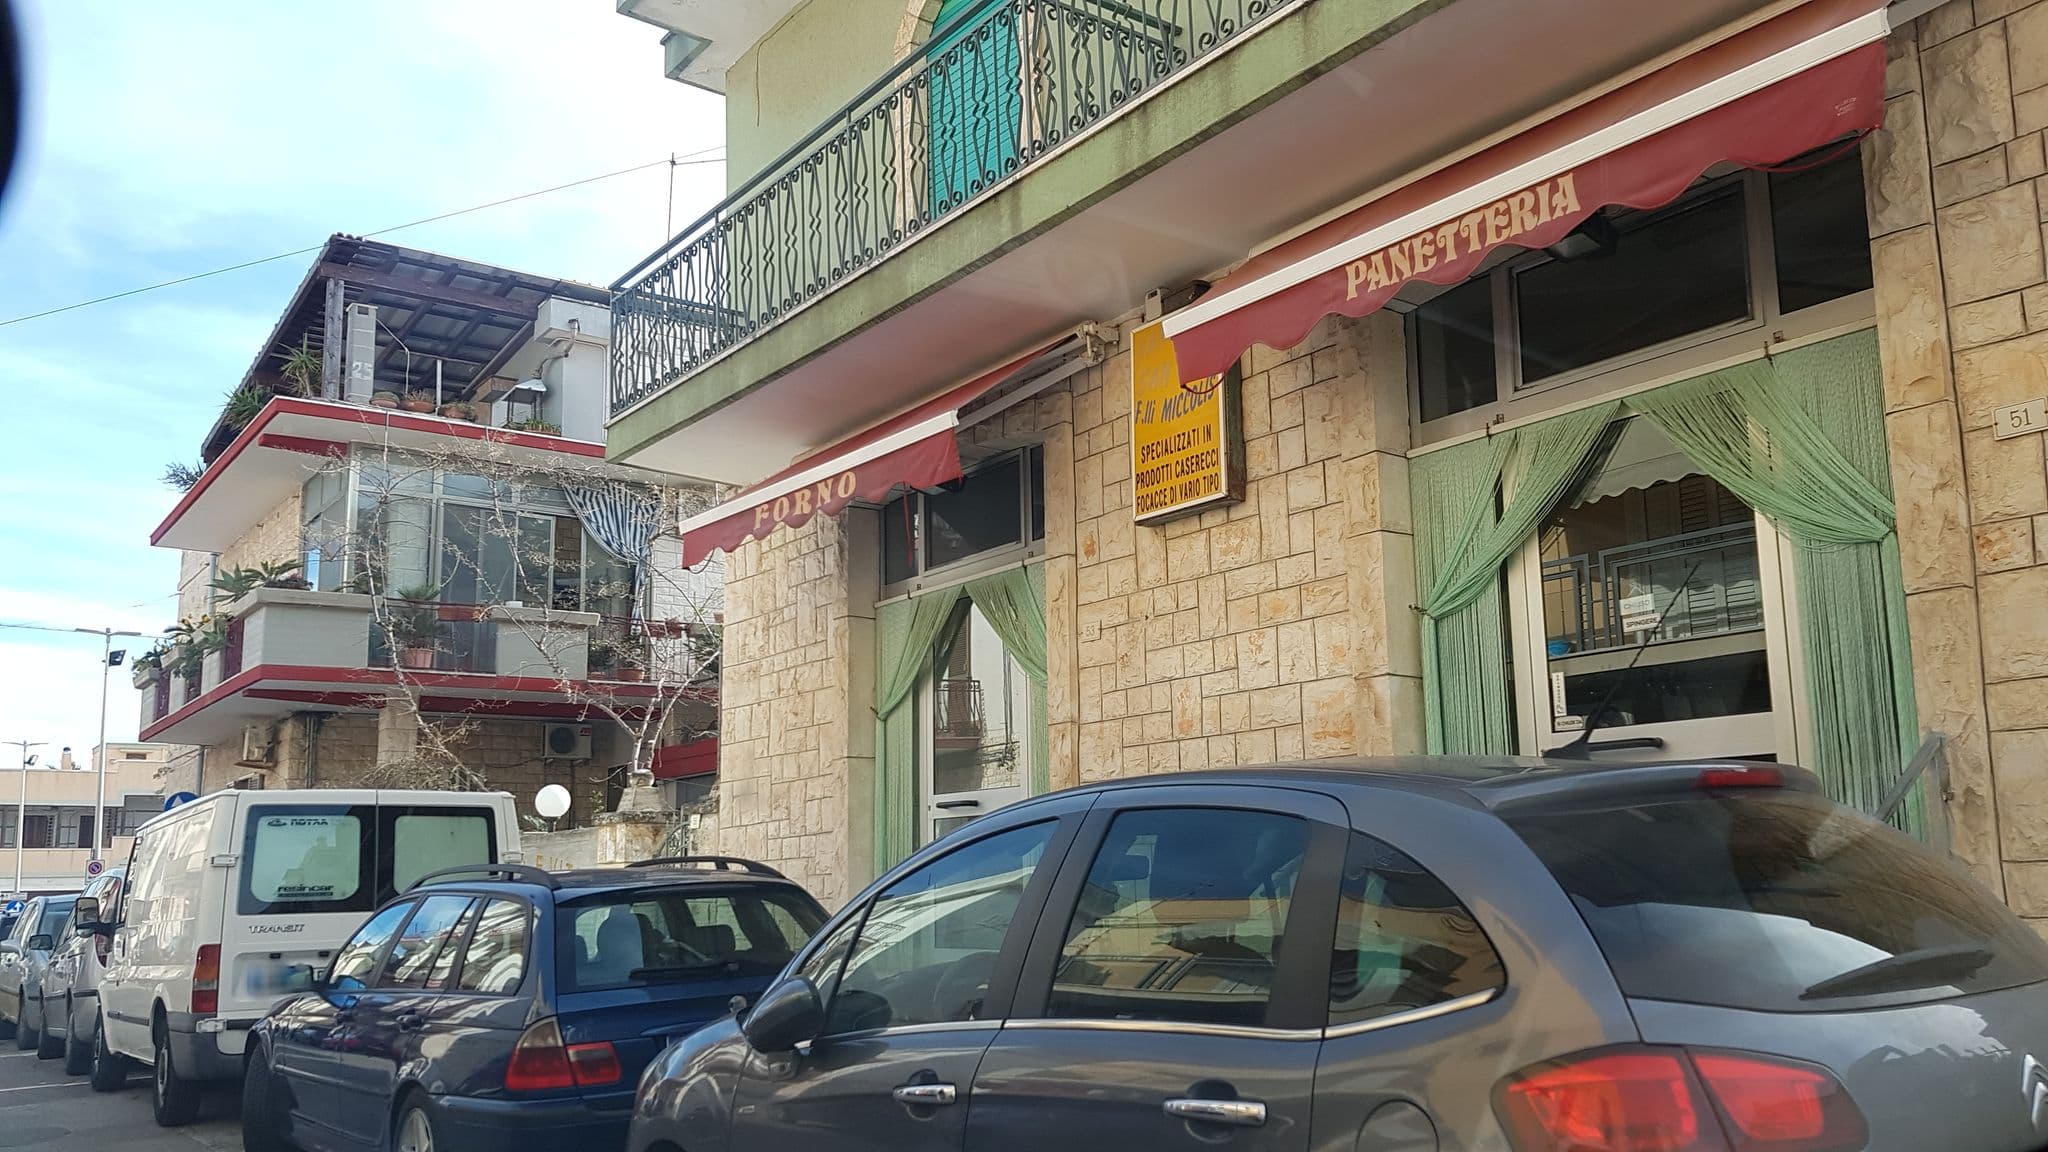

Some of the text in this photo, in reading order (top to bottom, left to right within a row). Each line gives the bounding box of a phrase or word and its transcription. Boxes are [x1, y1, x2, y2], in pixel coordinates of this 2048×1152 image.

[1346, 172, 1581, 301] PANETTERIA
[1161, 375, 1218, 423] MICCOLIS
[2010, 408, 2032, 428] 51
[1141, 424, 1212, 464] SPECIALIZZATI IN
[1135, 448, 1219, 491] PRODOTTI CASERECCI
[753, 471, 857, 530] FORNO
[1136, 472, 1219, 513] FOCACCE DI VARIO TIPO
[249, 923, 305, 935] TRANSIT
